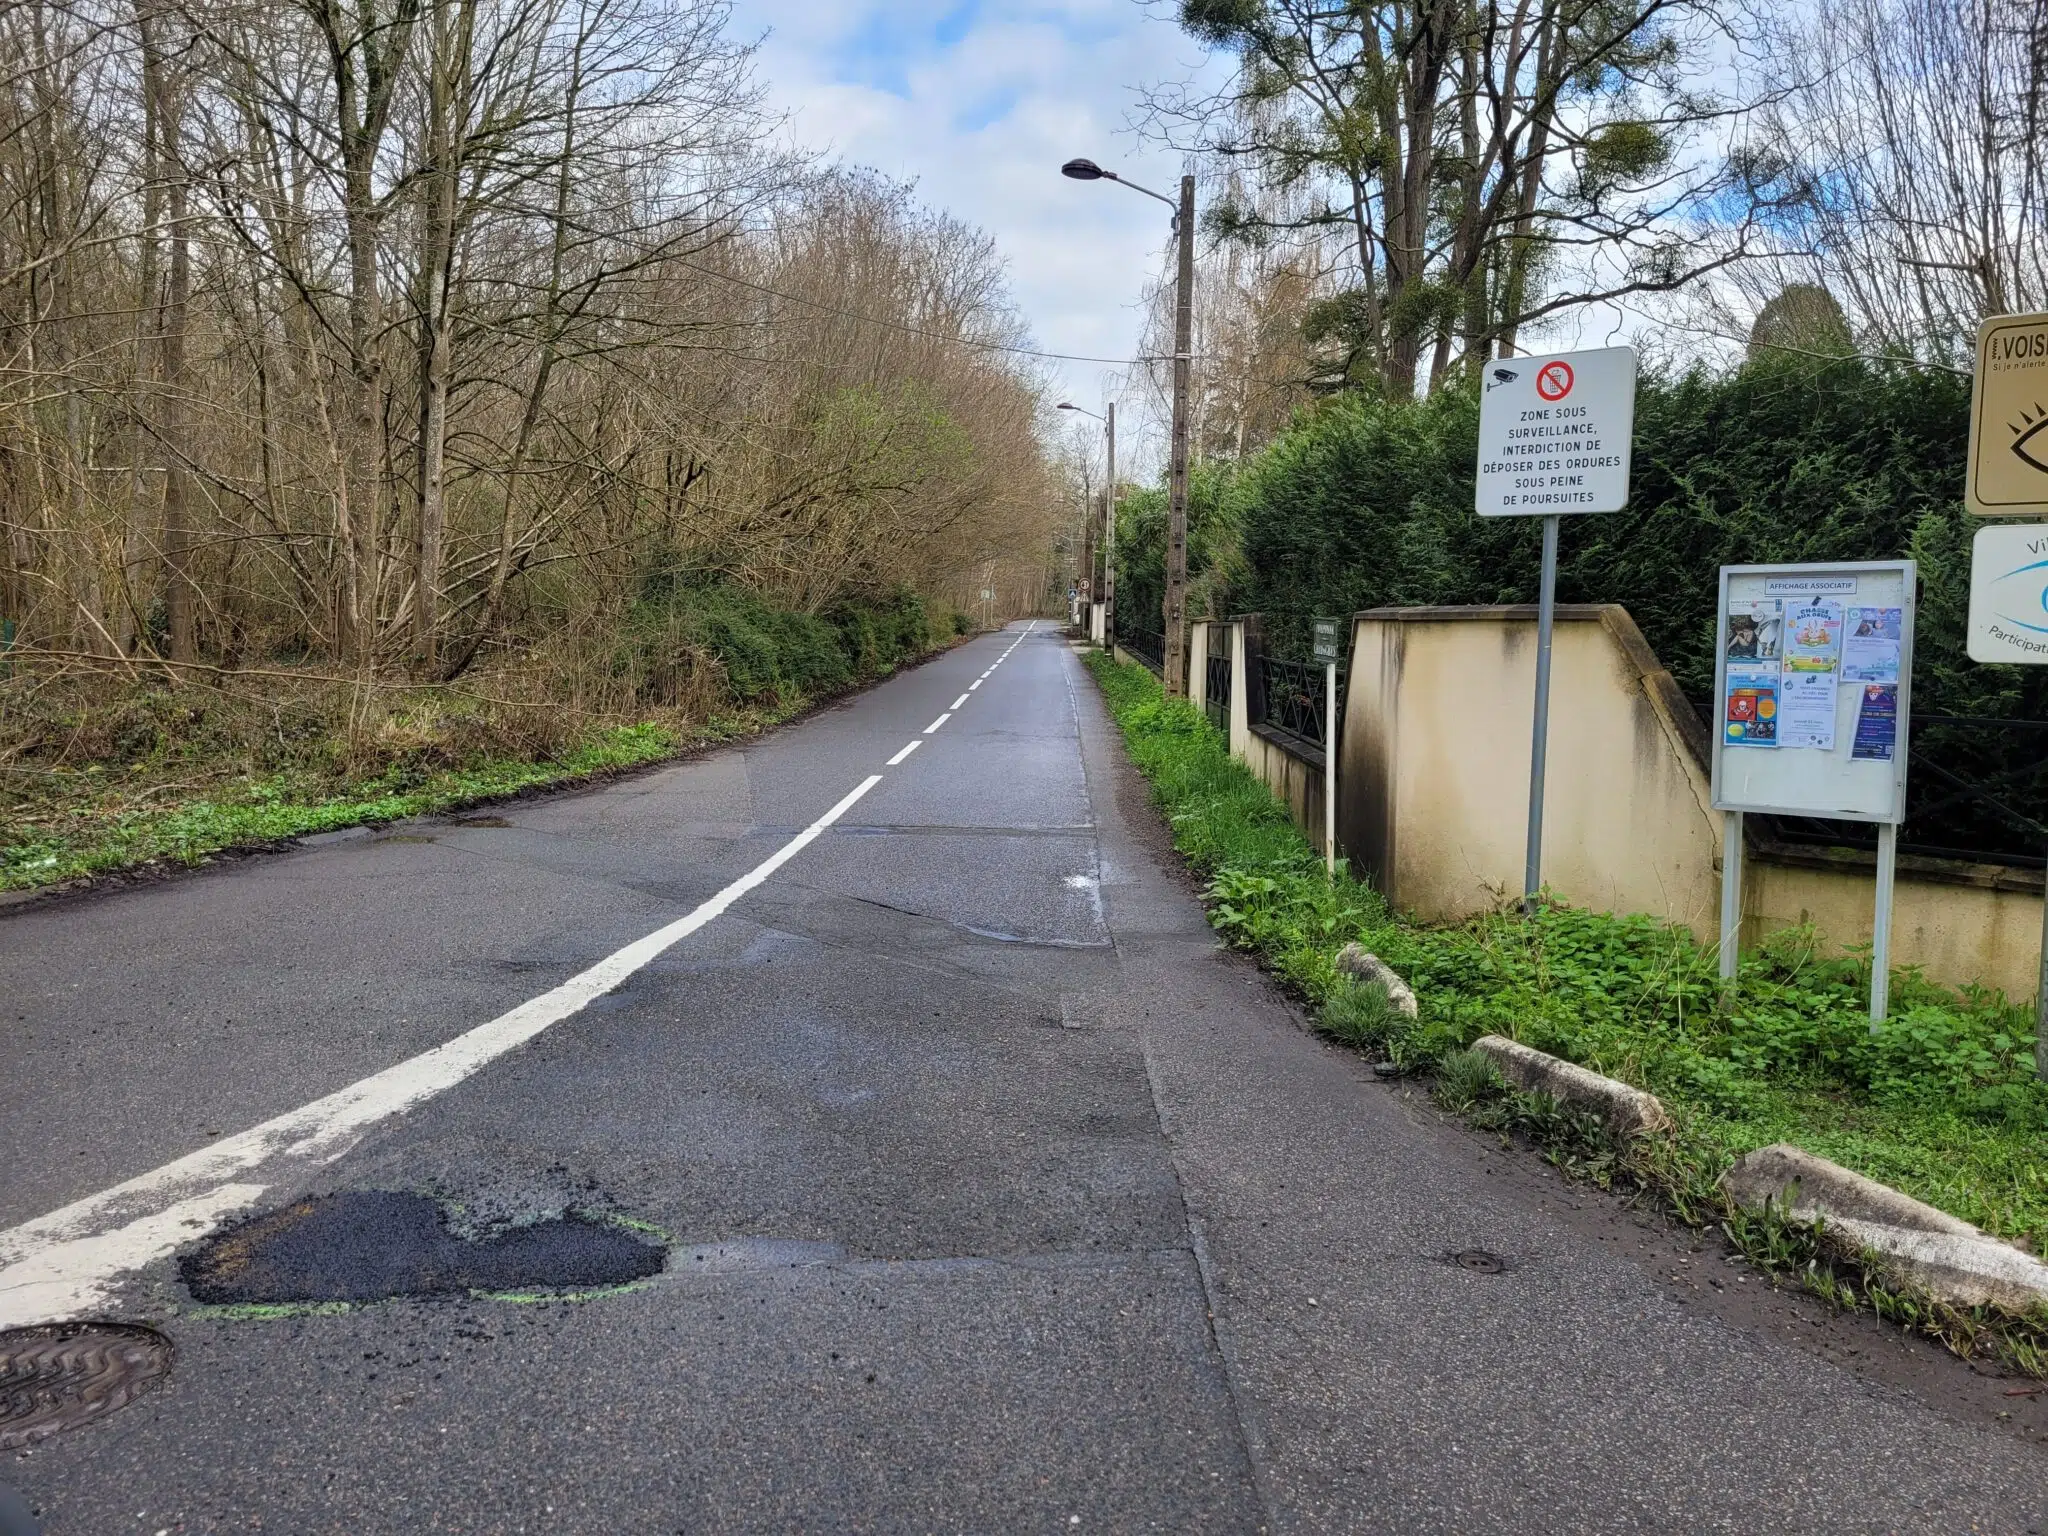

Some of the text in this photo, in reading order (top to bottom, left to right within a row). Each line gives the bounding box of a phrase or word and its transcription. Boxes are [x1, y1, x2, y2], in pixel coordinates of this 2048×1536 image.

[2003, 362, 2011, 373] je
[2014, 360, 2046, 370] n'alerte
[1520, 406, 1587, 422] ZONE SOUS
[1508, 423, 1598, 439] SURVEILLANCE,
[1502, 439, 1601, 457] INTERDICTION DE
[1483, 456, 1621, 474] DÉPOSER DES ORDURES
[1515, 475, 1584, 489] SOUS PEINE
[1503, 492, 1594, 506] DE POURSUITES
[1769, 582, 1853, 590] AFFICHAGE ASSOCIATIF
